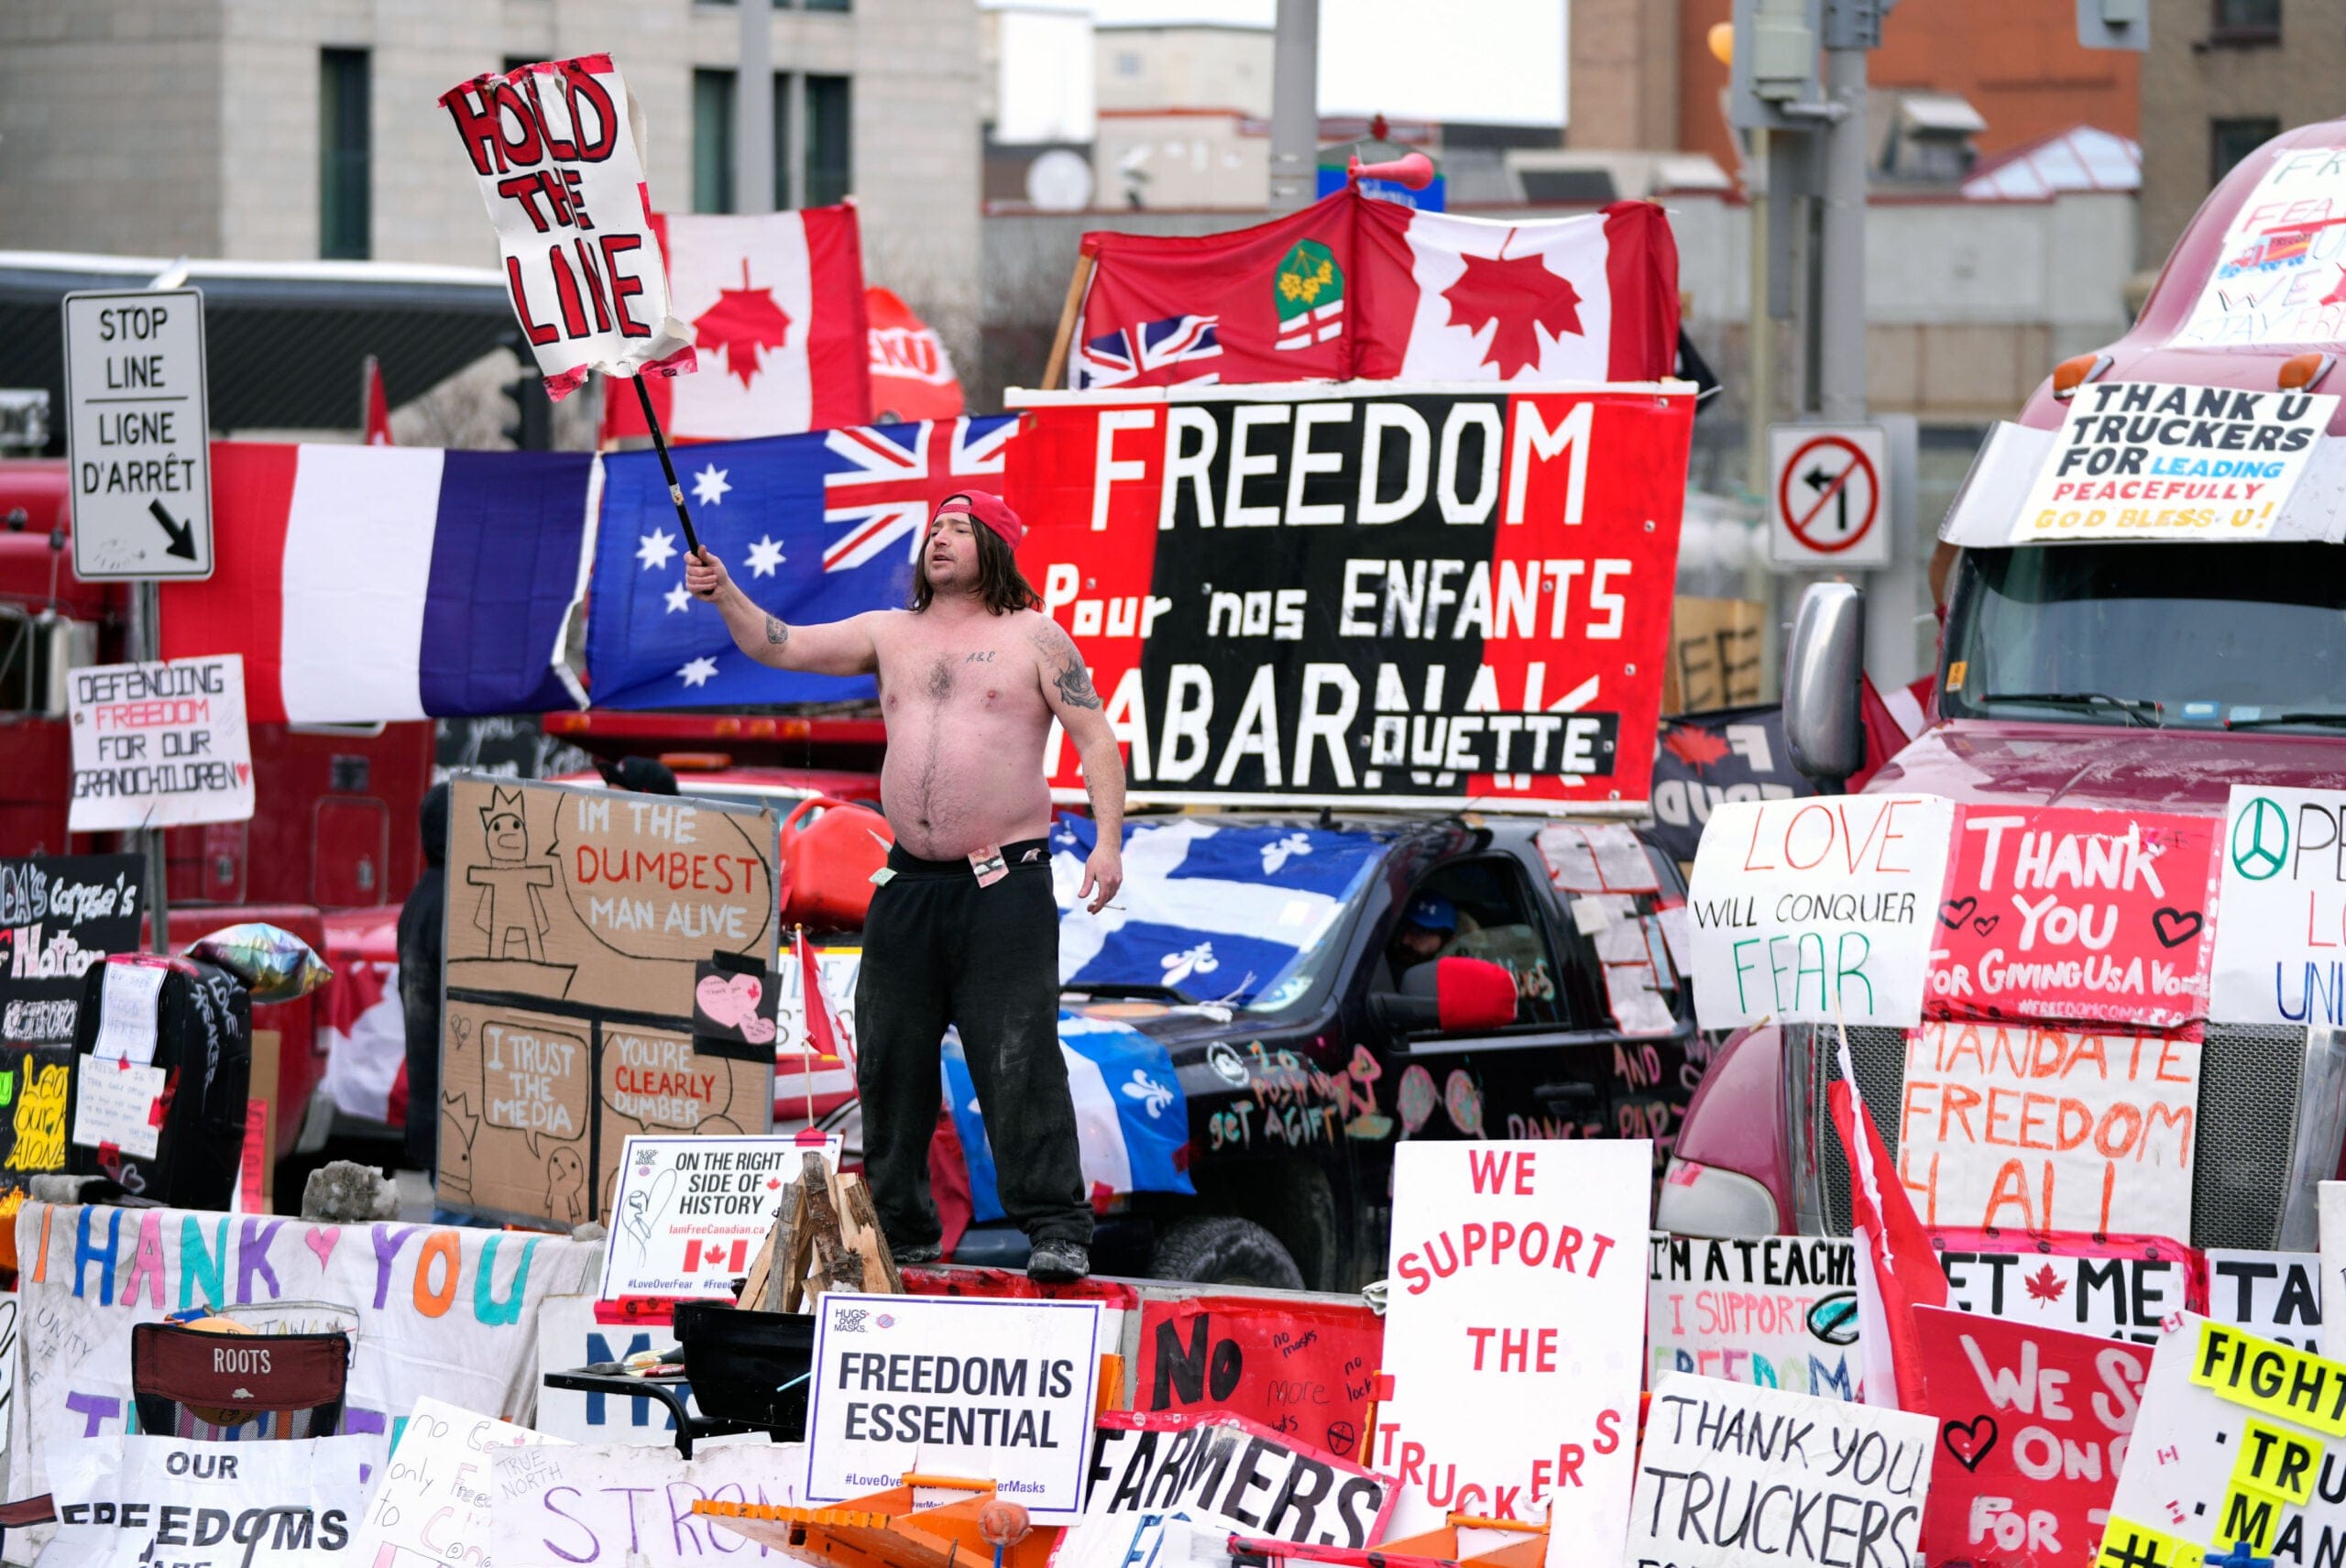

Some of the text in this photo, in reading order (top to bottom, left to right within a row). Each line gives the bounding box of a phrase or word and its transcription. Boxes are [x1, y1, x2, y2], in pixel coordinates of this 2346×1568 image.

[445, 57, 619, 176] HOLD
[497, 169, 593, 233] THE
[506, 233, 653, 347] LINE
[100, 307, 168, 343] STOP
[106, 355, 167, 389] LINE
[2094, 384, 2313, 422] THANK U
[99, 411, 176, 446] LIGNE
[2072, 415, 2315, 452] TRUCKERS
[82, 453, 196, 494] D'ARRÊT
[1091, 400, 1595, 532] FREEDOM
[2055, 447, 2286, 479] FOR LEADING
[2053, 481, 2264, 502] PEACEFULLY
[2034, 510, 2107, 530] GOD
[2116, 508, 2216, 529] BLESS
[1044, 558, 1632, 641] Pour nos ENFANTS
[78, 663, 225, 705] DEFENDING
[95, 699, 210, 730] FREEDOM
[99, 731, 212, 762] FOR OUR
[73, 762, 238, 798] GRANDCHILDREN
[579, 795, 696, 844] I'M THE
[1744, 800, 1923, 874] LOVE
[576, 844, 759, 894] DUMBEST
[1966, 814, 2166, 900] THANK
[590, 897, 749, 939] MAN ALIVE
[1694, 892, 1916, 930] WILL CONQUER
[2012, 894, 2118, 952] YOU
[1733, 931, 1874, 1016] FEAR
[488, 1027, 576, 1075] I TRUST
[616, 1035, 694, 1072] YOU'RE
[1909, 1022, 2193, 1084] MANDATE
[509, 1070, 554, 1101] THE
[615, 1063, 716, 1103] CLEARLY
[492, 1099, 573, 1133] MEDIA
[614, 1091, 699, 1126] DUMBER
[1902, 1080, 2193, 1169] FREEDOM
[675, 1152, 784, 1171] ON THE RIGHT
[1469, 1149, 1537, 1196] WE
[688, 1174, 763, 1192] SIDE OF
[679, 1196, 765, 1214] HISTORY
[669, 1224, 765, 1234] IamFreeCanadian.ca
[372, 1222, 546, 1326] YOU
[1397, 1220, 1617, 1296] SUPPORT
[1650, 1238, 1692, 1282] I'M
[1705, 1238, 1730, 1282] A
[628, 1278, 693, 1289] #LoveOverFear
[2077, 1257, 2172, 1327] ME
[835, 1309, 867, 1320] HUGS
[839, 1317, 863, 1326] over
[1669, 1290, 1815, 1335] I SUPPORT
[1273, 1332, 1290, 1348] no
[1283, 1330, 1318, 1358] masks
[1467, 1326, 1558, 1374] THE
[213, 1347, 272, 1375] ROOTS
[839, 1352, 1074, 1398] FREEDOM IS
[1344, 1356, 1363, 1375] no
[1959, 1332, 2072, 1420] WE
[412, 1414, 449, 1439] no
[845, 1402, 1058, 1449] ESSENTIAL
[166, 1451, 239, 1480] OUR
[495, 1449, 546, 1479] TRUE
[1377, 1408, 1622, 1521] TRUCKERS
[1662, 1395, 1925, 1498] THANK YOU
[390, 1457, 434, 1497] only
[500, 1462, 565, 1500] NORTH
[1084, 1426, 1384, 1552] FARMERS
[60, 1503, 350, 1552] FREEDOMS
[373, 1488, 400, 1528] to
[1634, 1466, 1920, 1568] TRUCKERS
[1968, 1496, 2063, 1554] FOR
